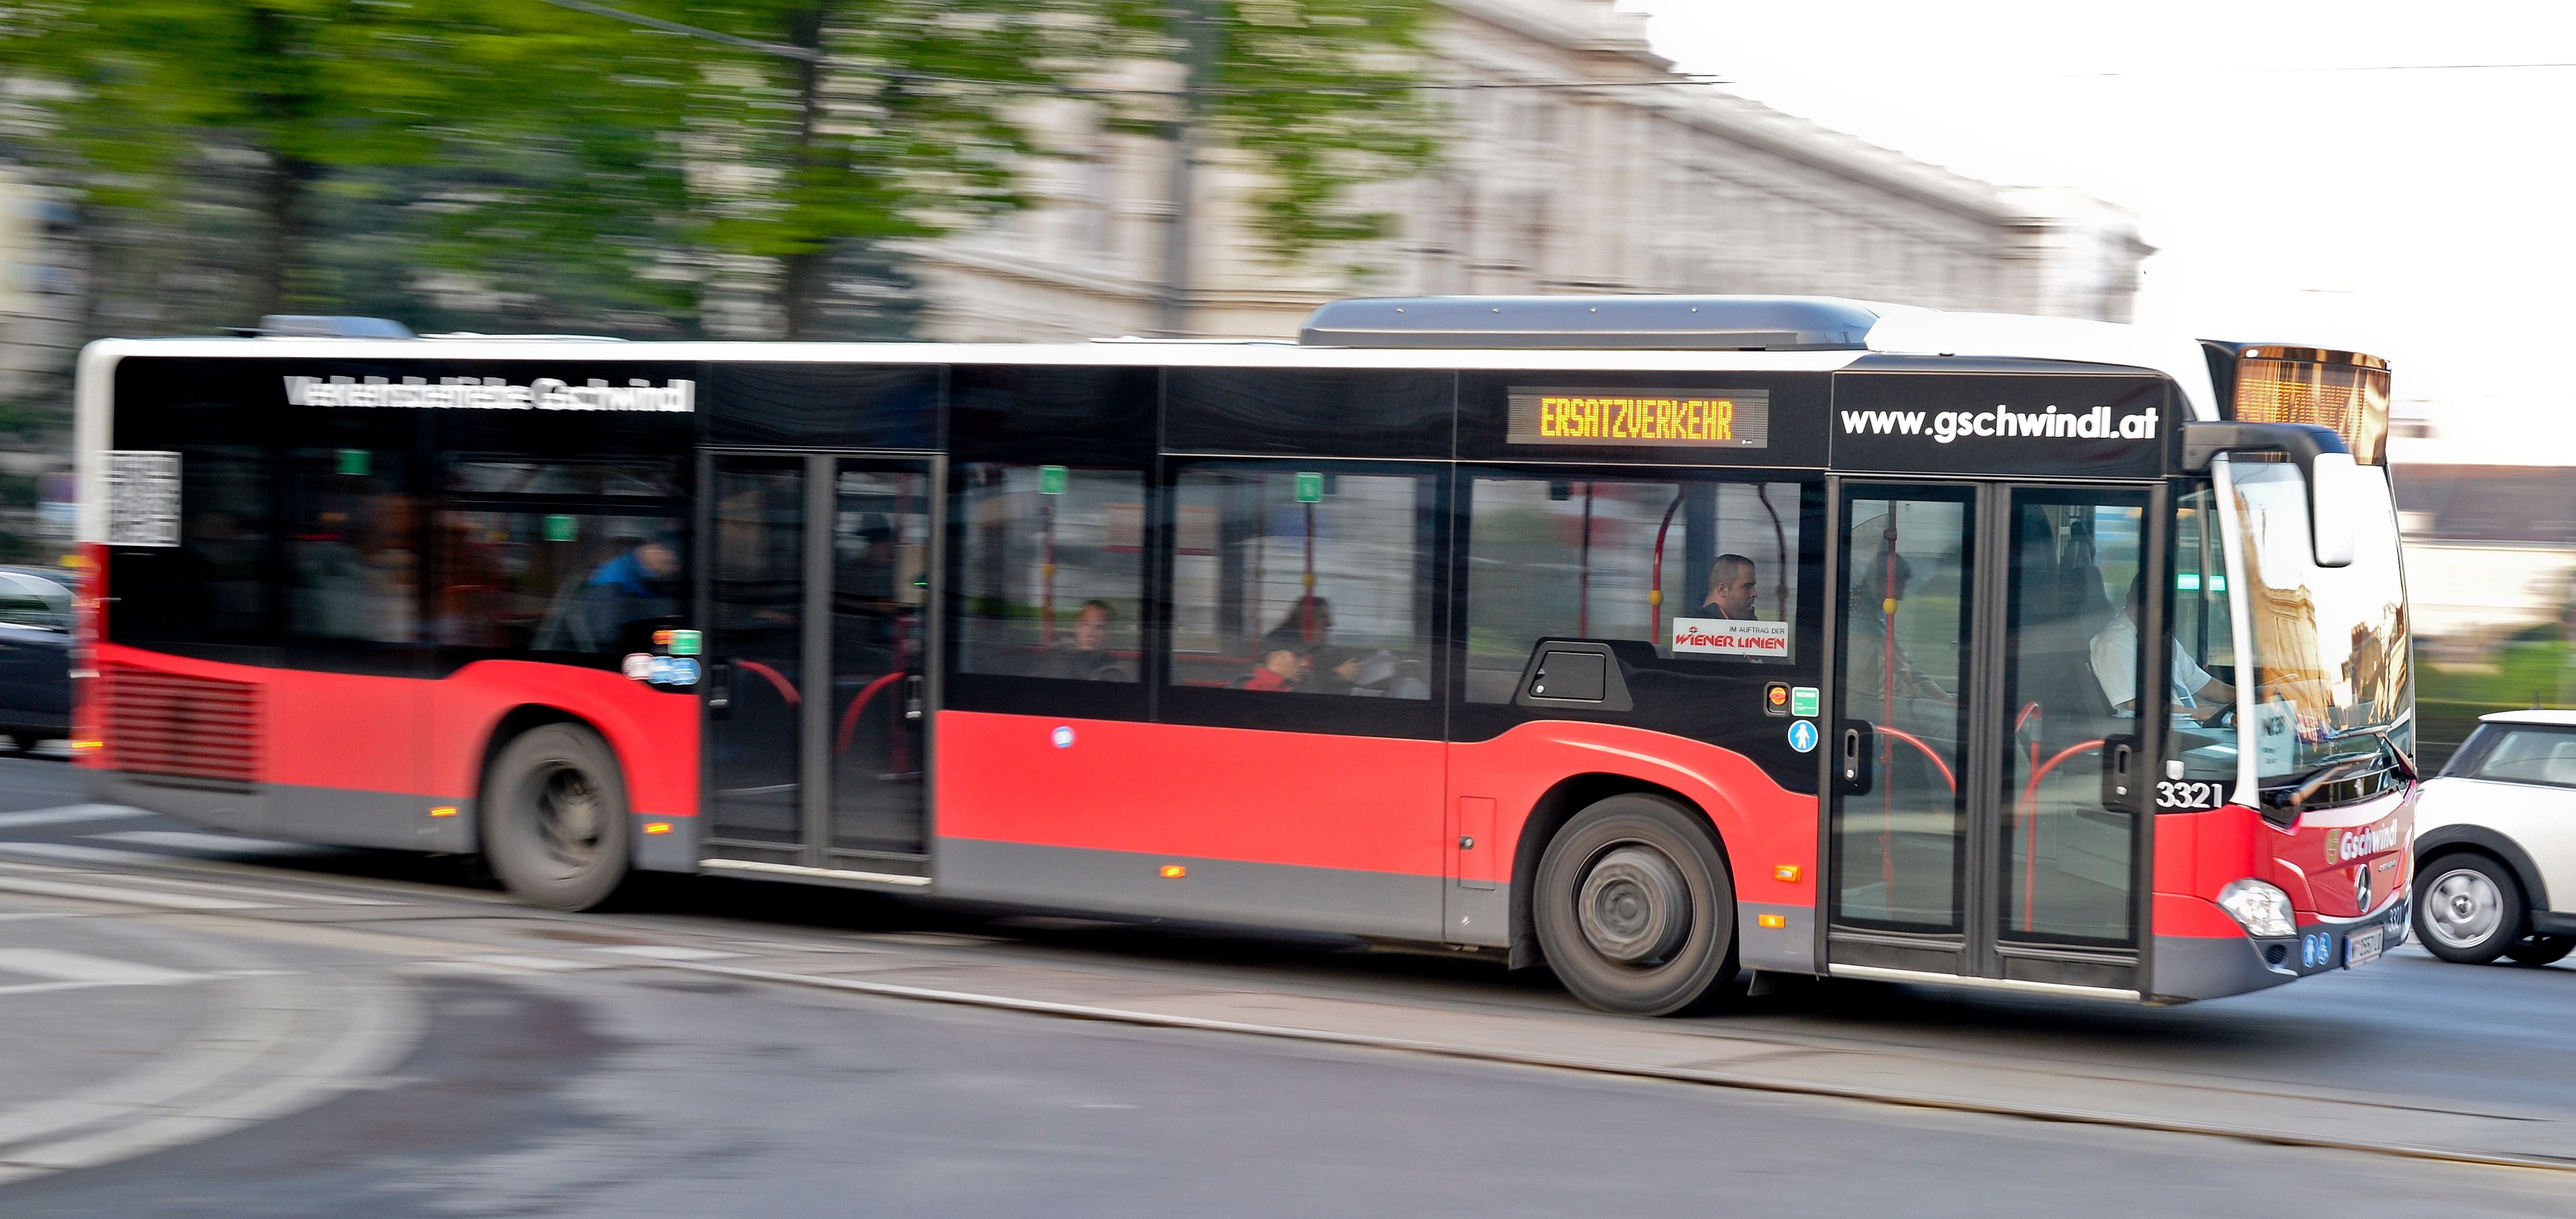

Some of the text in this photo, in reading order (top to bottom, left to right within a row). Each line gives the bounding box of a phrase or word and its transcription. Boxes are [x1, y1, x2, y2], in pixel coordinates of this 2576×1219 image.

[1541, 398, 1732, 440] ERSATZVERKEHR
[1840, 405, 2159, 444] www.gschwindl.at
[1675, 634, 1785, 650] WIENER LINIEN
[2155, 781, 2222, 808] 3321
[2340, 819, 2398, 861] Gschwindl
